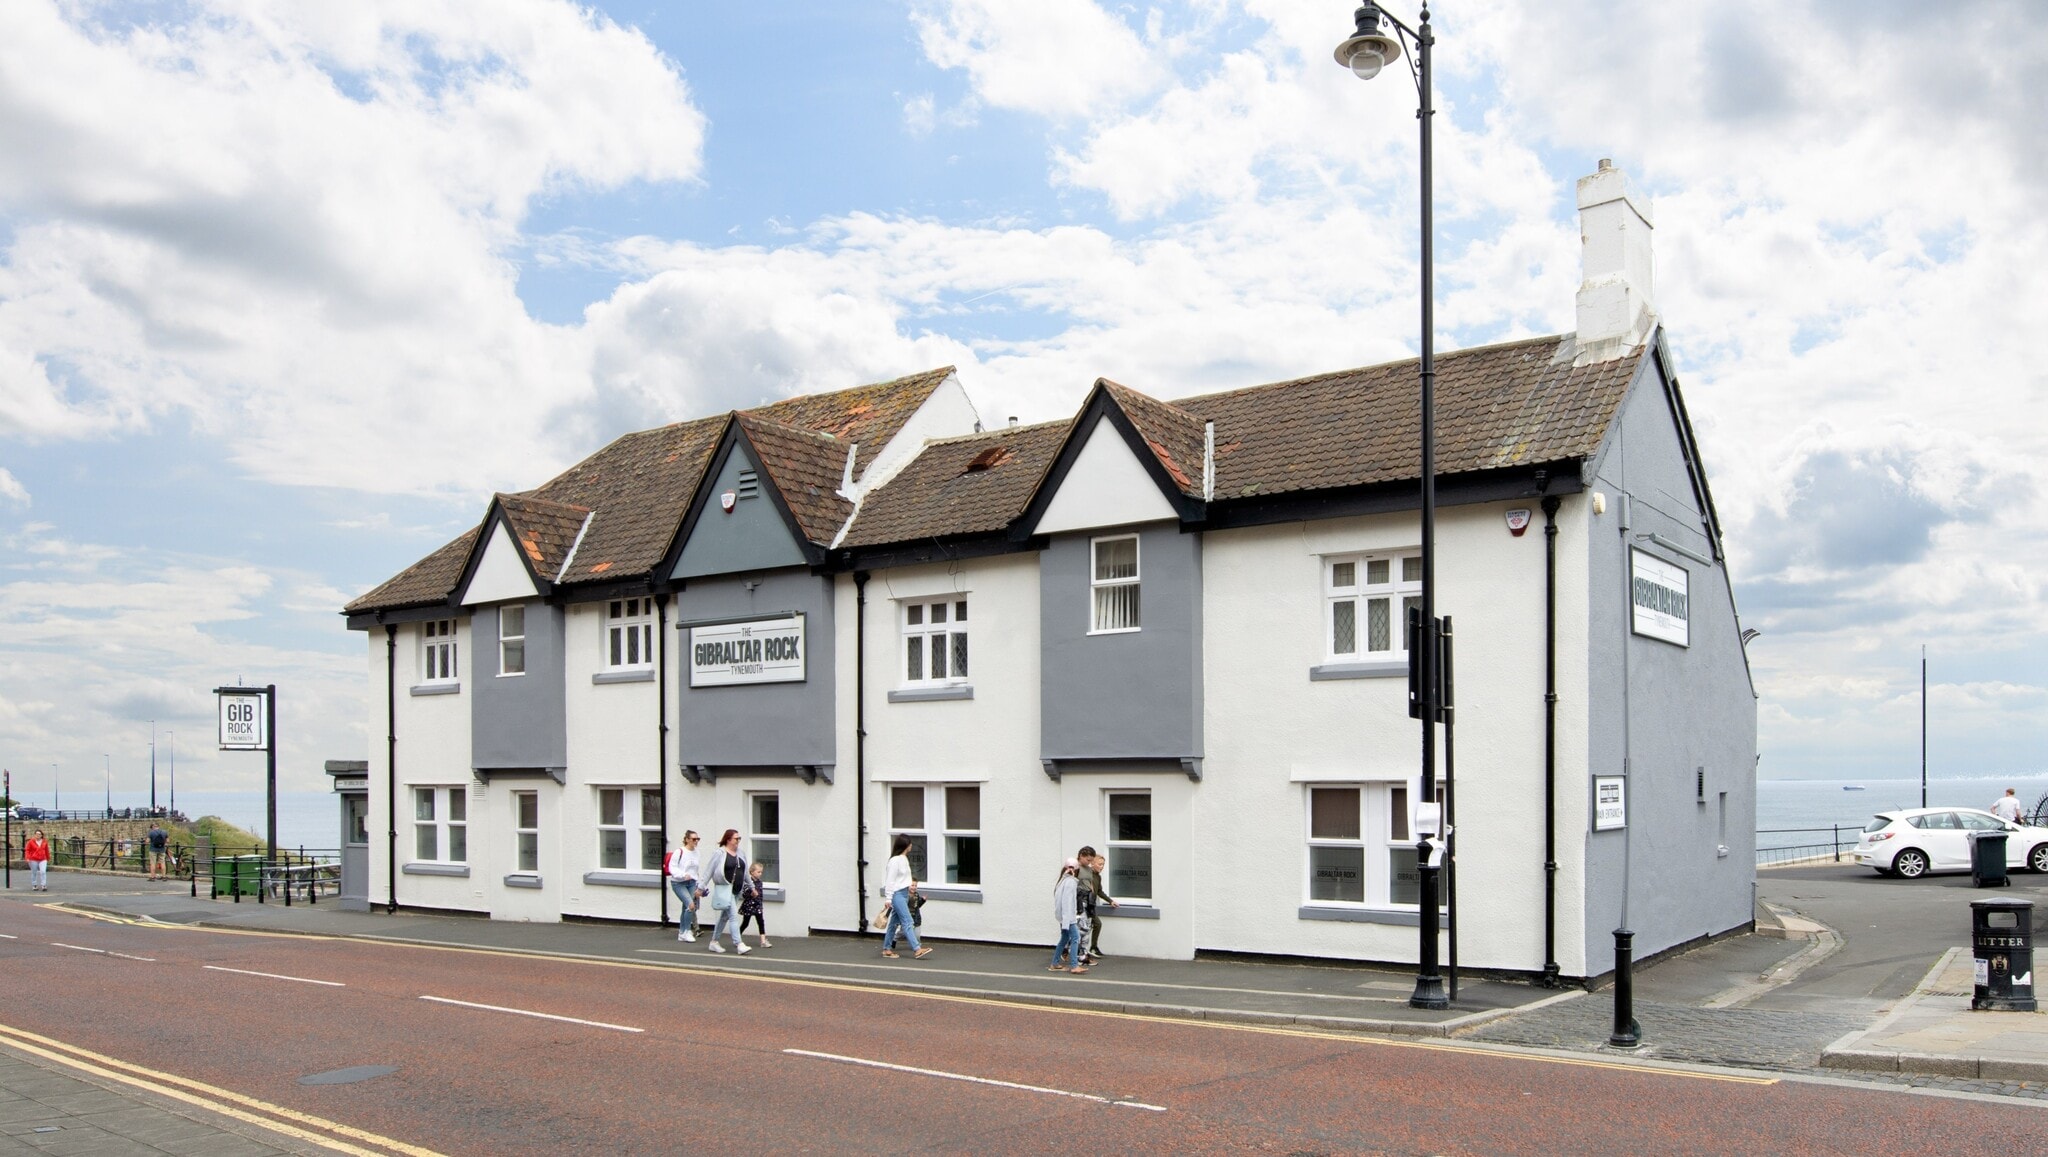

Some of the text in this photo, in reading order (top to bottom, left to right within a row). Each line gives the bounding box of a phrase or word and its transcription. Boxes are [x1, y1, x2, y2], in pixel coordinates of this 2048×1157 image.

[1634, 576, 1687, 621] GIBRALTAR ROCK
[741, 627, 752, 637] THE
[694, 635, 800, 667] GIBRALTAR ROCK
[730, 663, 764, 676] TYNEMOUTH
[227, 704, 253, 722] GIB
[227, 722, 253, 734] ROCK
[1316, 869, 1357, 879] GIBRALTAR ROCK
[1978, 937, 2024, 947] LITTER
